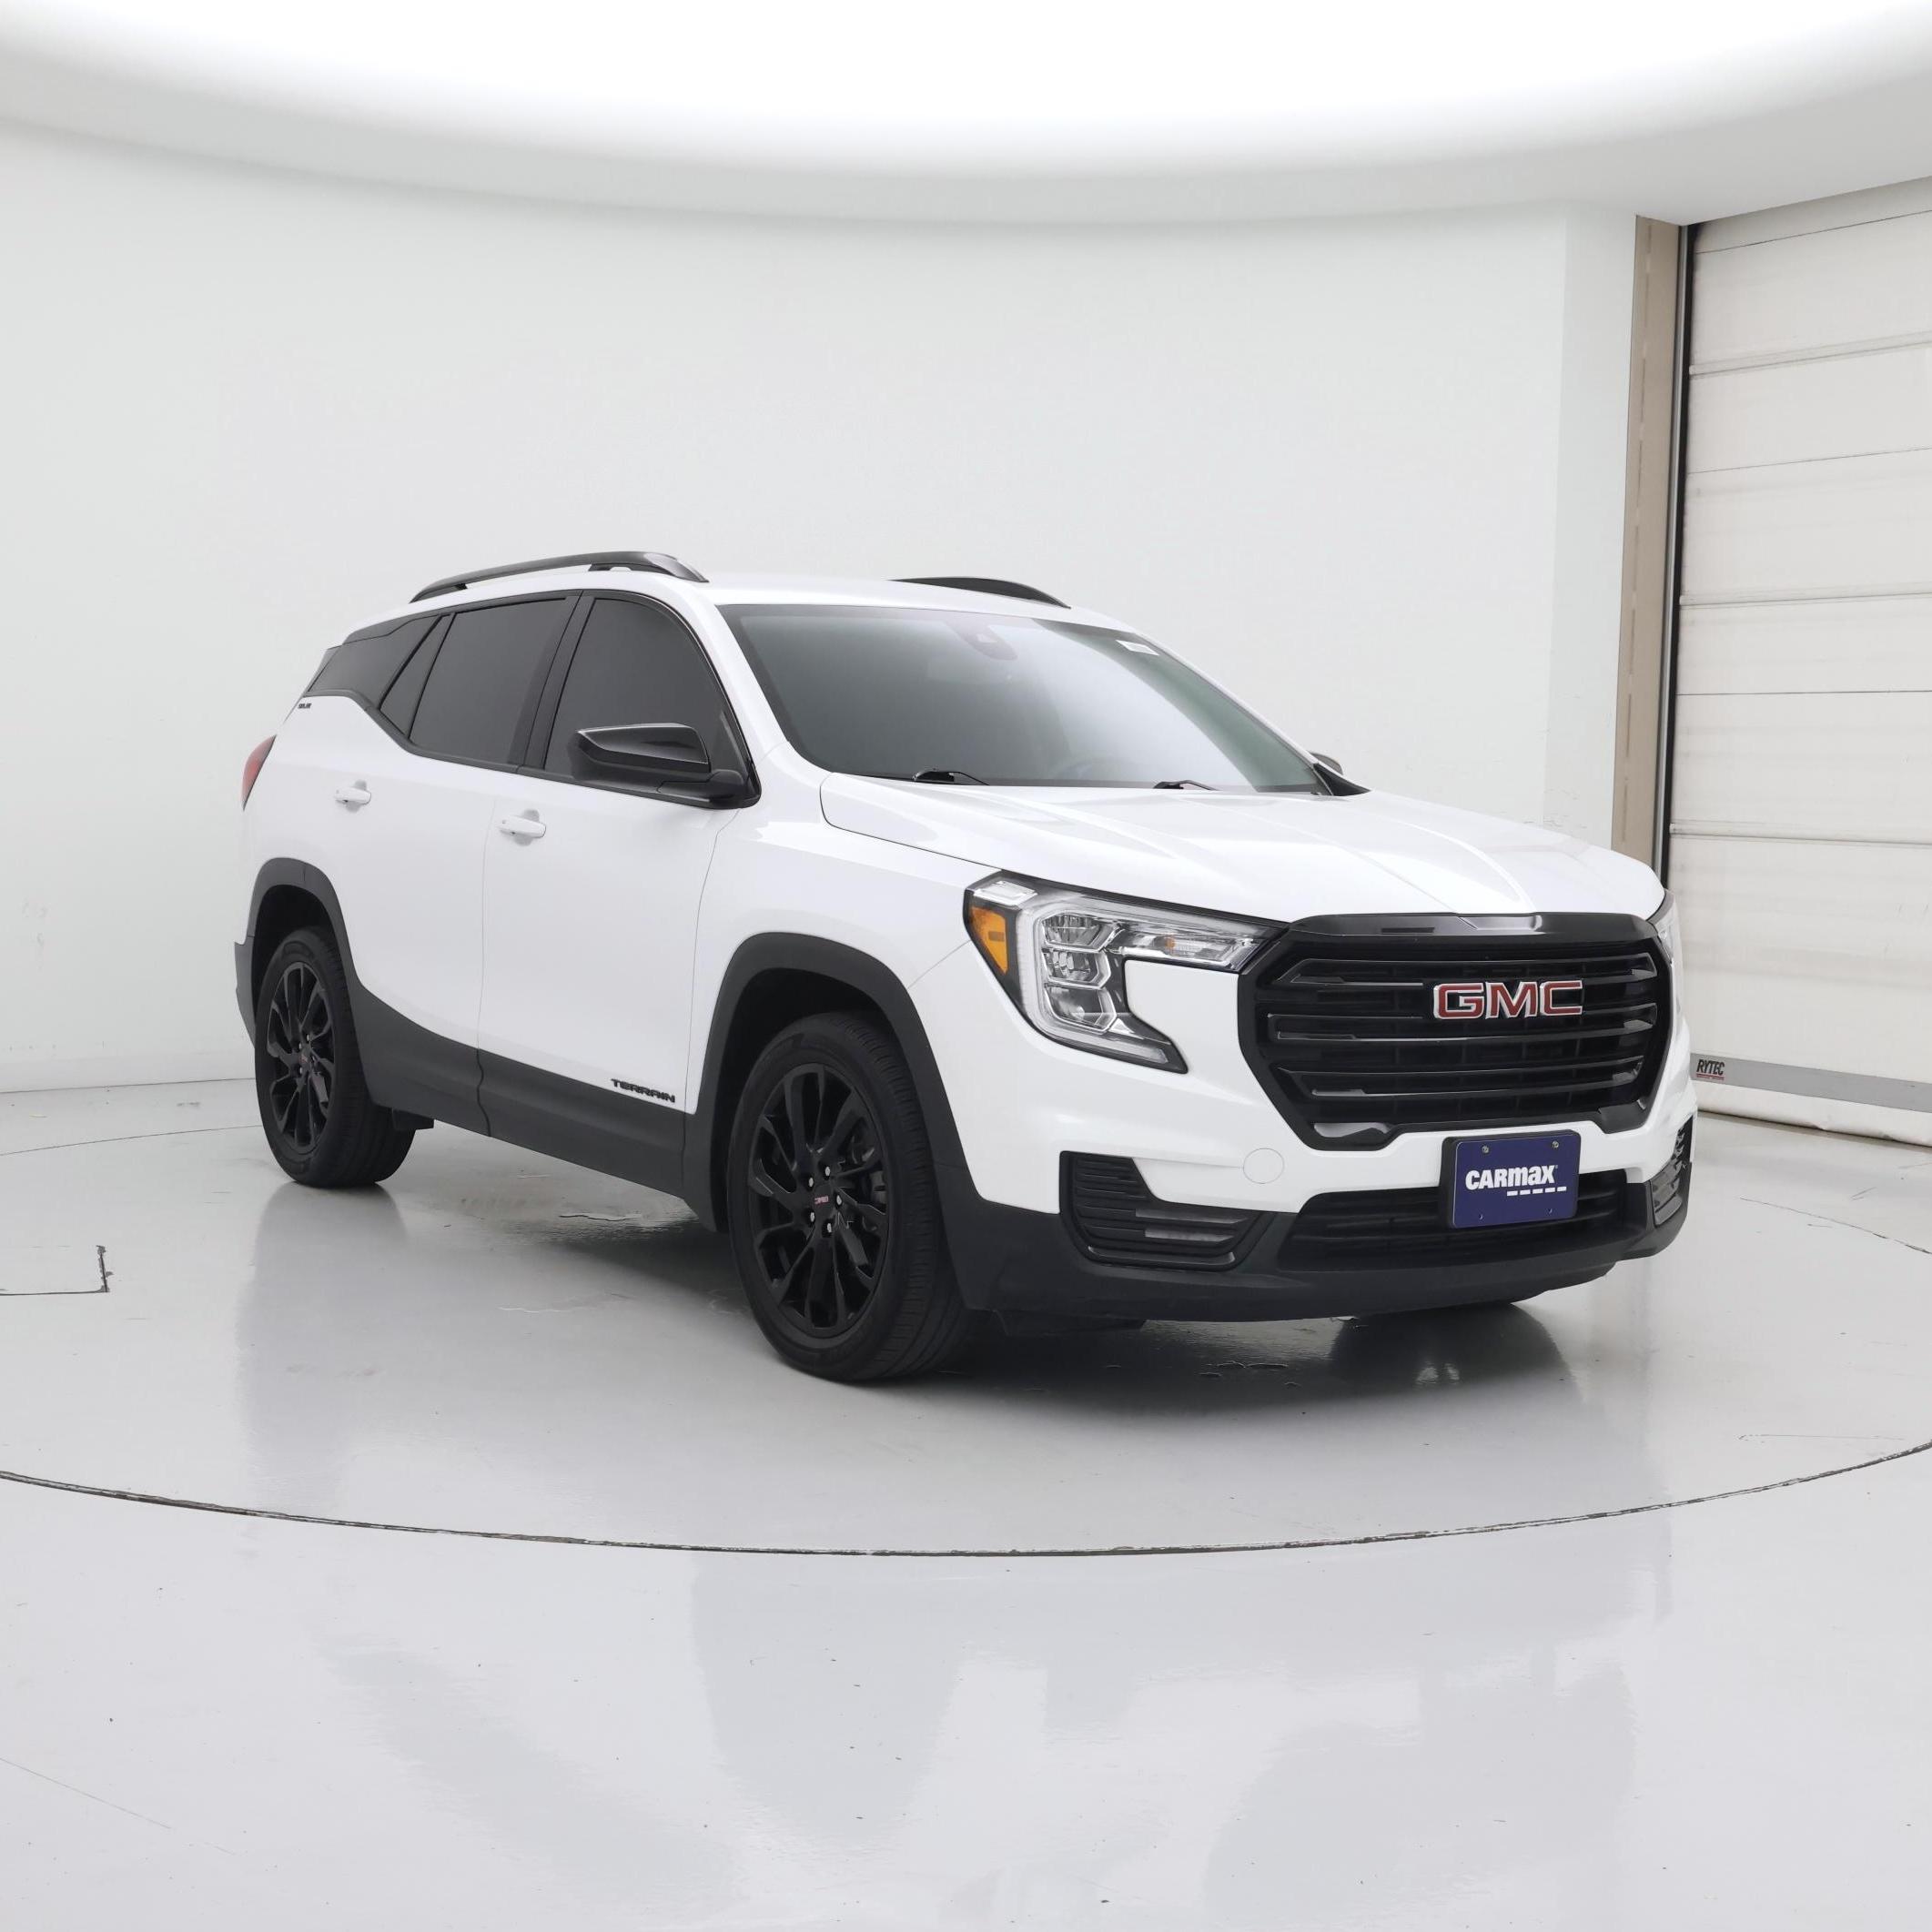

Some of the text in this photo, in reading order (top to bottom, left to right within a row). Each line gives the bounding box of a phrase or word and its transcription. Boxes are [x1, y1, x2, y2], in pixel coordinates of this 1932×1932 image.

[1433, 980, 1583, 1019] GMC
[1696, 1058, 1725, 1076] RYTEC
[611, 1078, 675, 1103] TERRAIN
